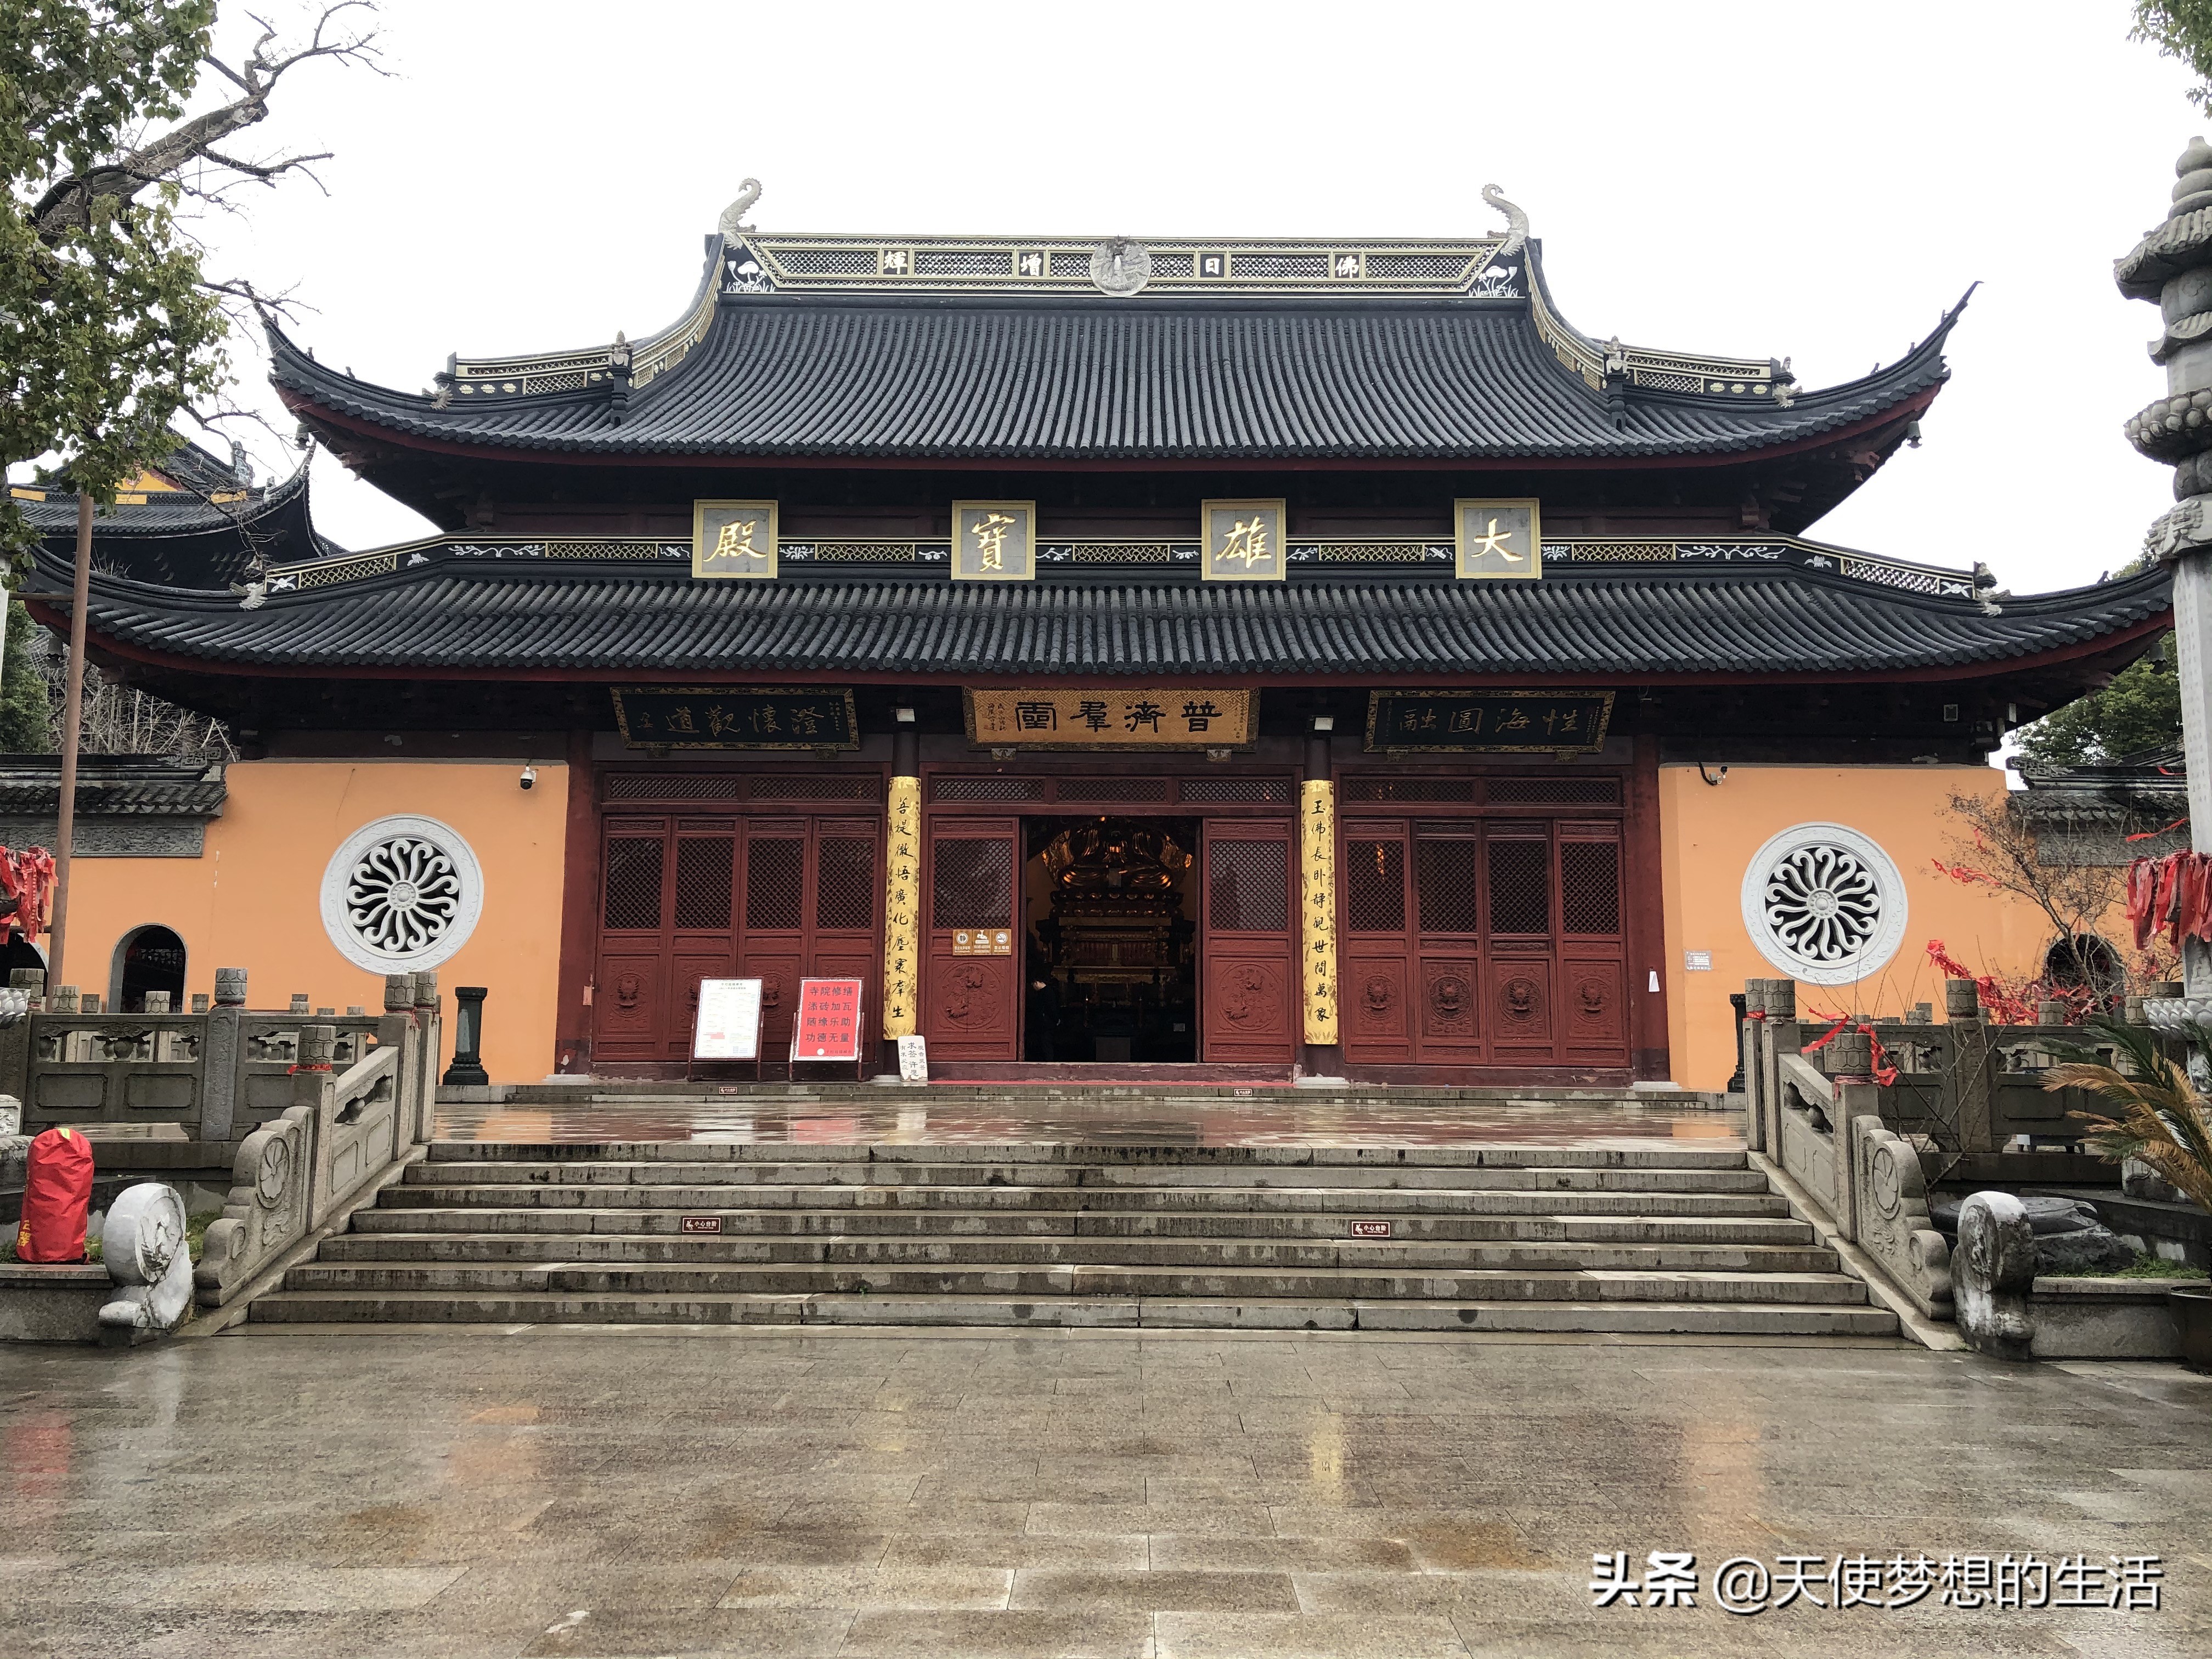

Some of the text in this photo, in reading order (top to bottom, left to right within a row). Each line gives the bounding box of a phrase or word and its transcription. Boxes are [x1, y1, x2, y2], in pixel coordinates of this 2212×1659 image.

[883, 250, 1360, 279] 佛 日 增 輝
[703, 513, 1523, 572] 大 雄 寶 殿
[809, 986, 853, 996] 寺院修缮
[808, 1001, 851, 1011] 添砖加瓦
[806, 1017, 851, 1027] 随缘乐助
[805, 1032, 849, 1042] 功德无量
[907, 1042, 919, 1077] 求签许愿
